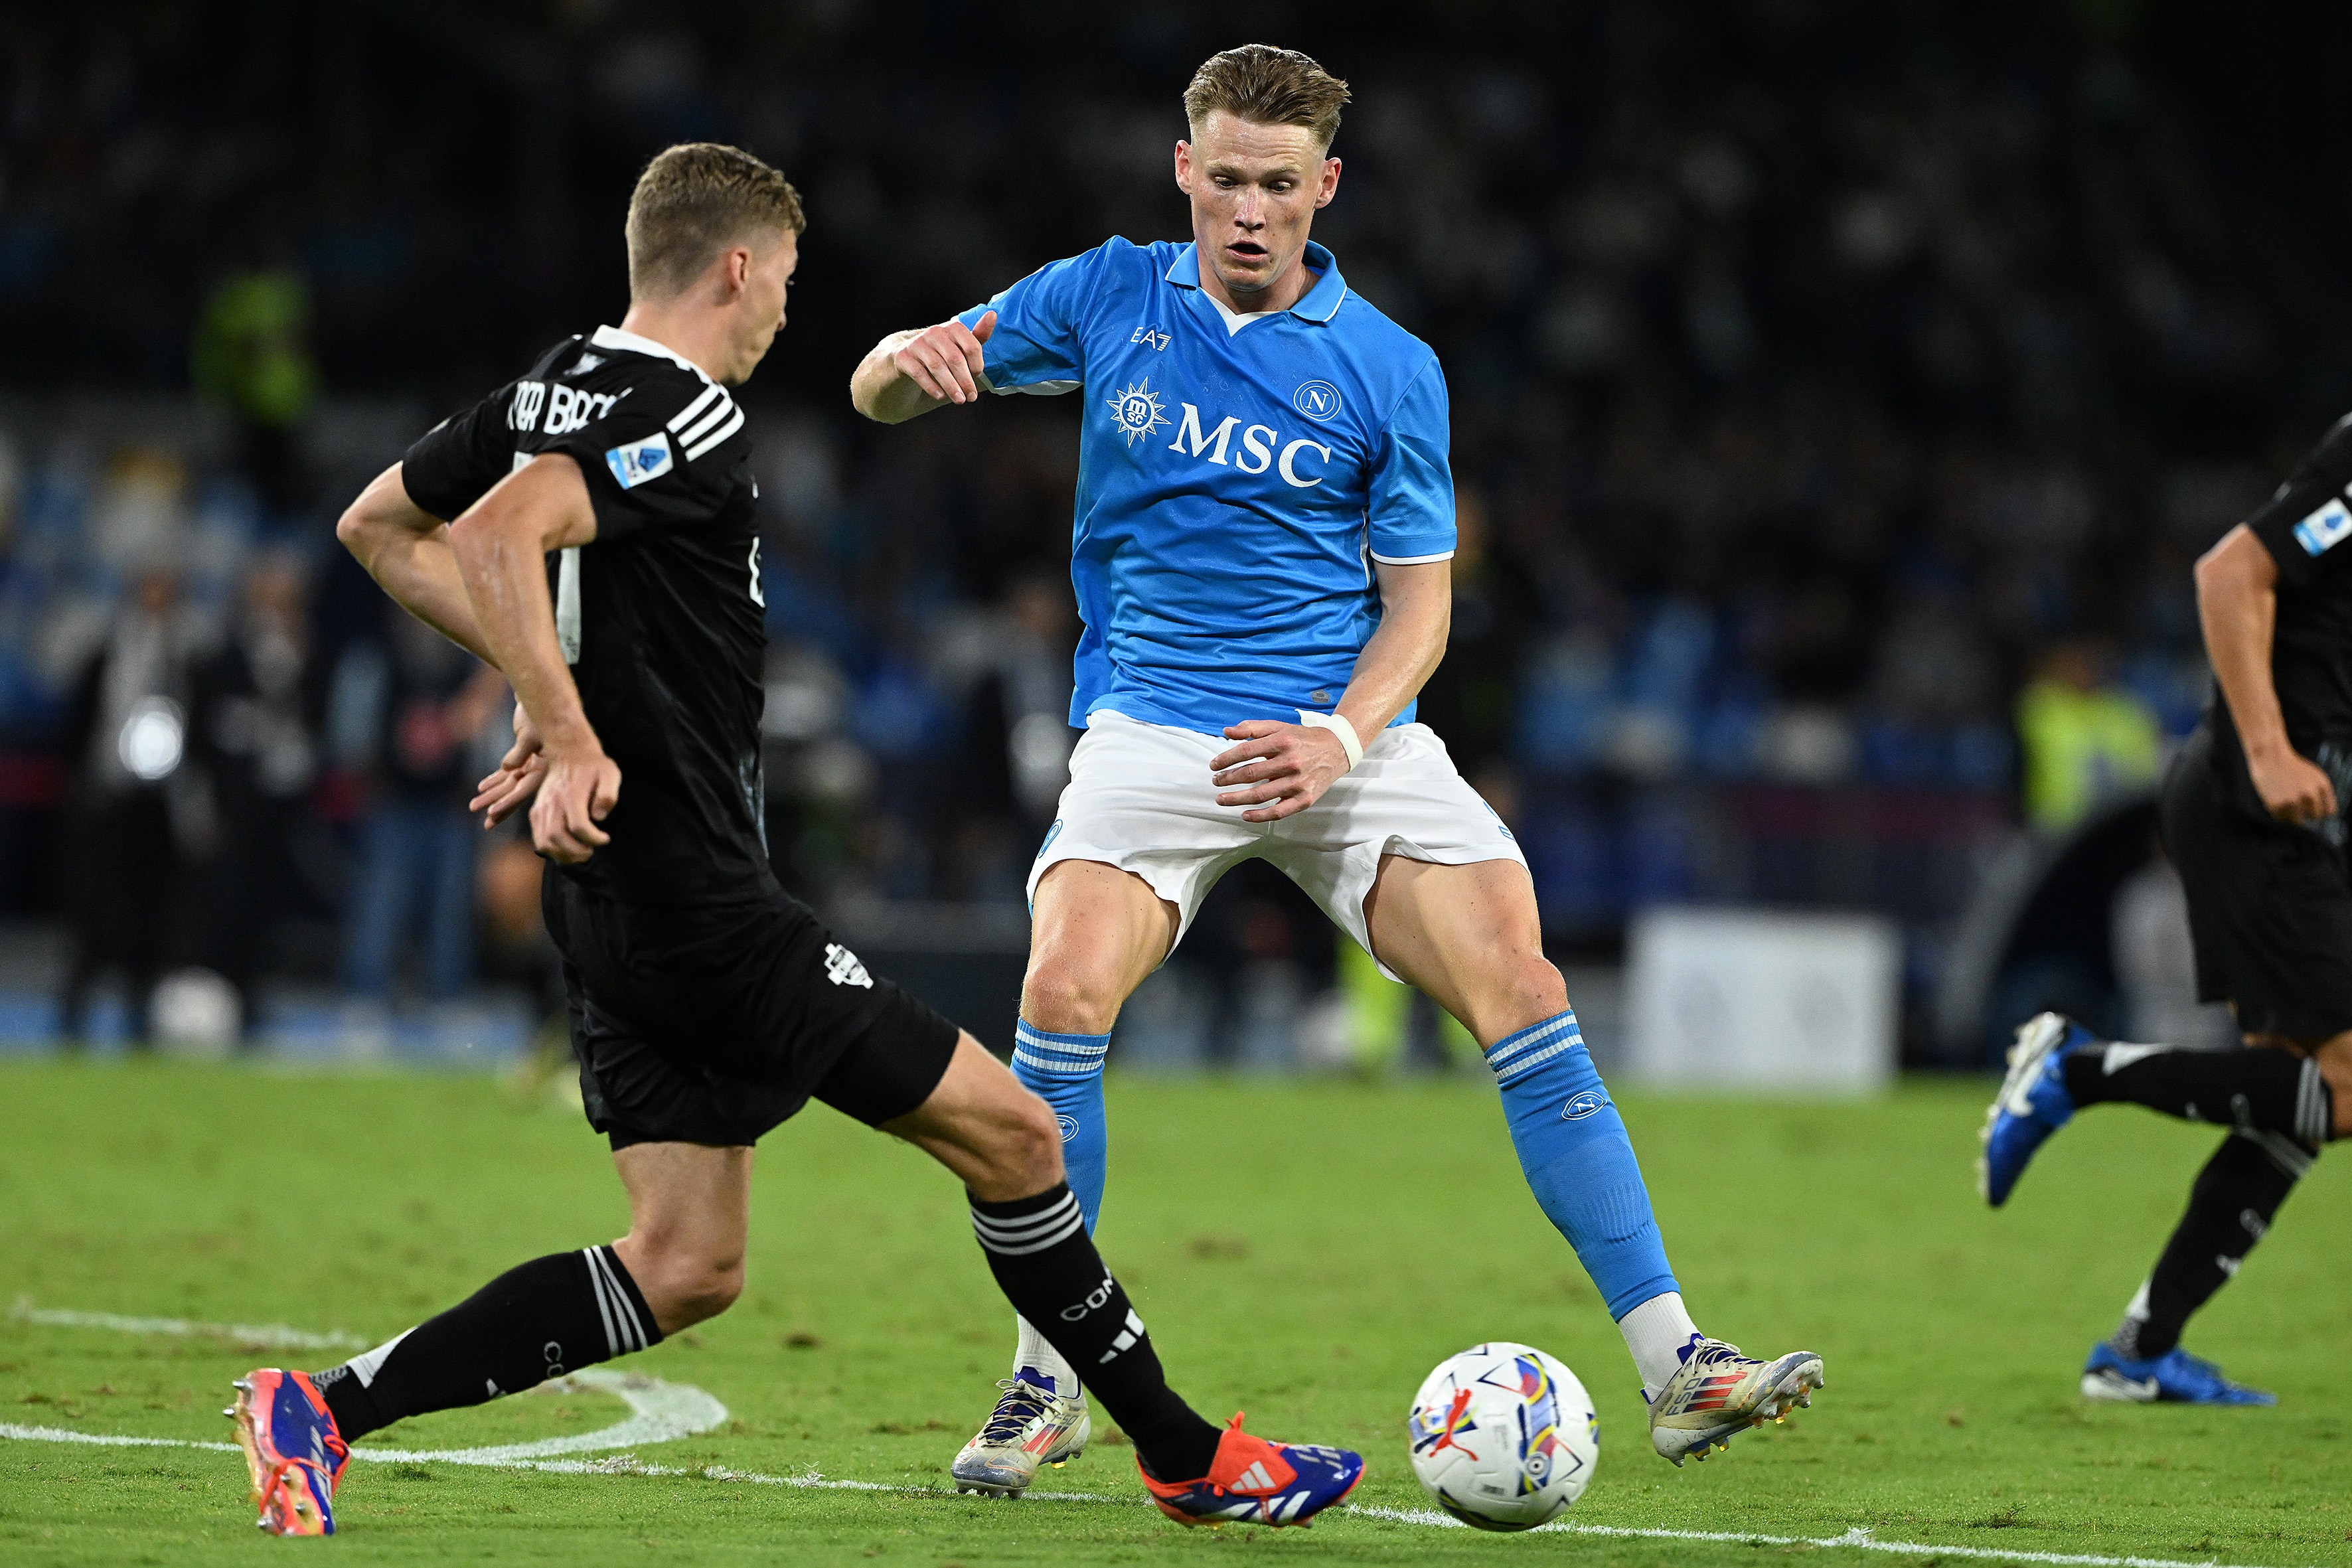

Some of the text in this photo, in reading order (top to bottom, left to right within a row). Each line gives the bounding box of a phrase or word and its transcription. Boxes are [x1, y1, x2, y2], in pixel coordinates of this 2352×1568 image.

[1130, 326, 1172, 352] EA7
[1305, 390, 1329, 412] N
[1168, 402, 1331, 488] MSC
